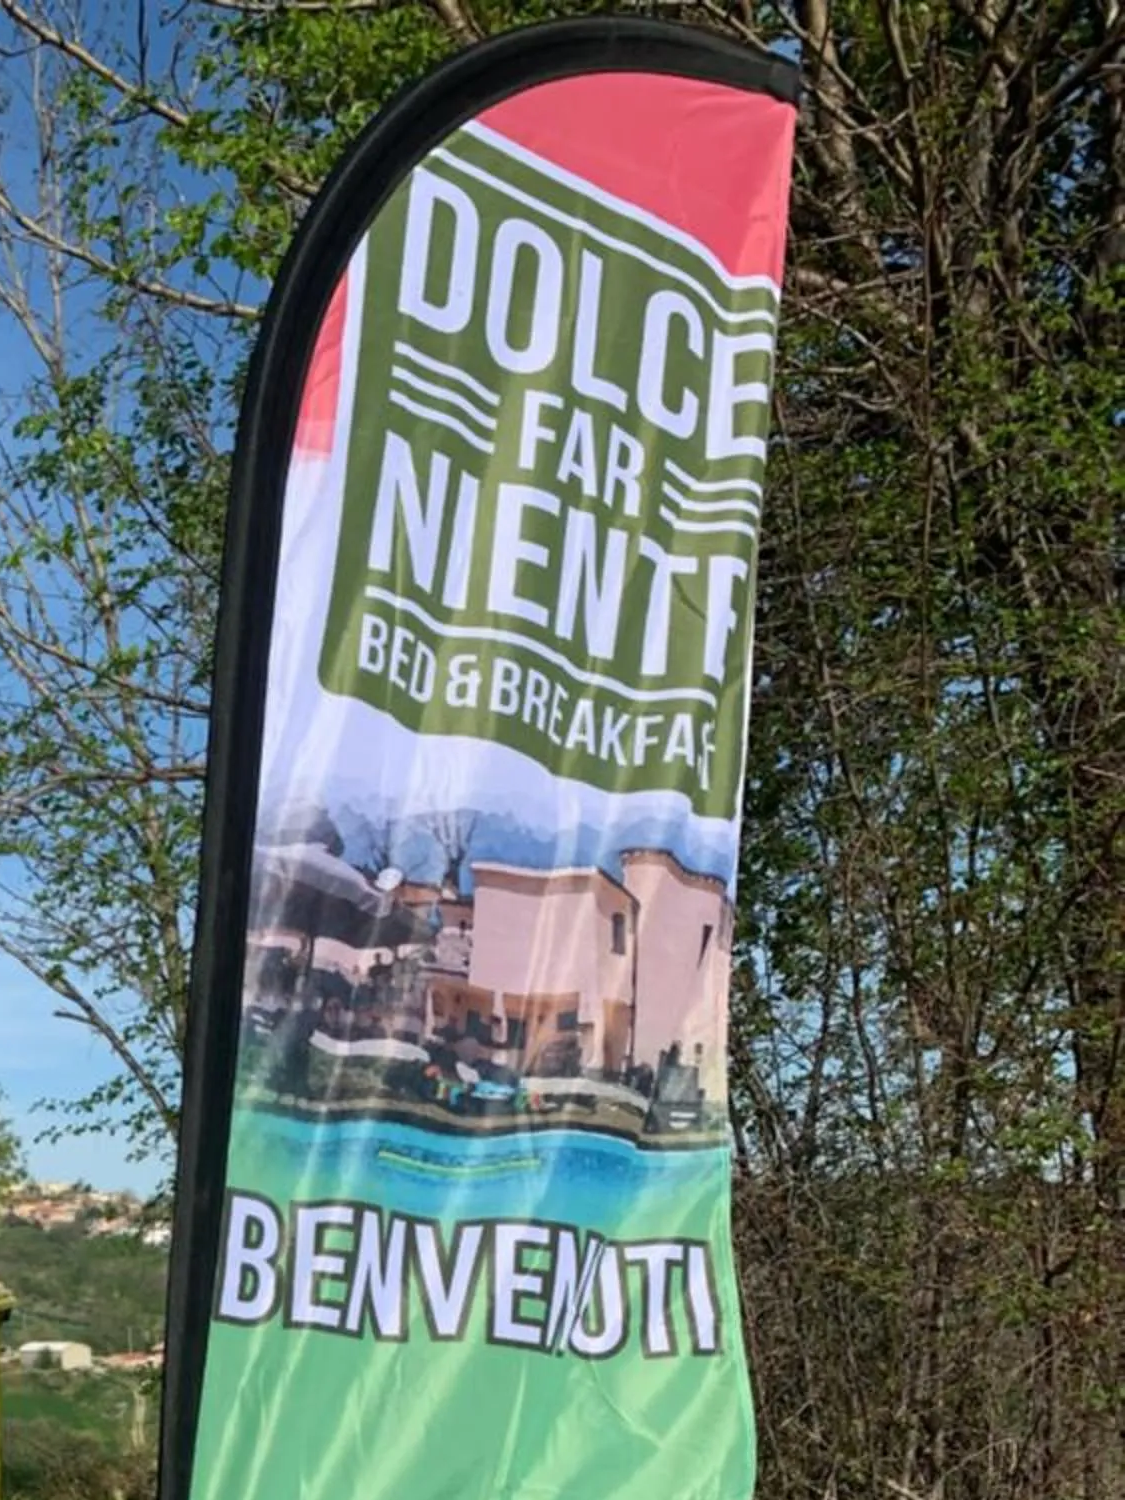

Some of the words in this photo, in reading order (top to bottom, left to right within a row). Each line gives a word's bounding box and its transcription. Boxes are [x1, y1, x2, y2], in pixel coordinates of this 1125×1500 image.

[397, 168, 773, 461] DOLCE
[518, 390, 645, 516] FAR
[358, 613, 435, 702] BED
[445, 654, 479, 708] &
[489, 660, 717, 791] BREAKFA
[215, 1190, 721, 1357] BENVENUTI
